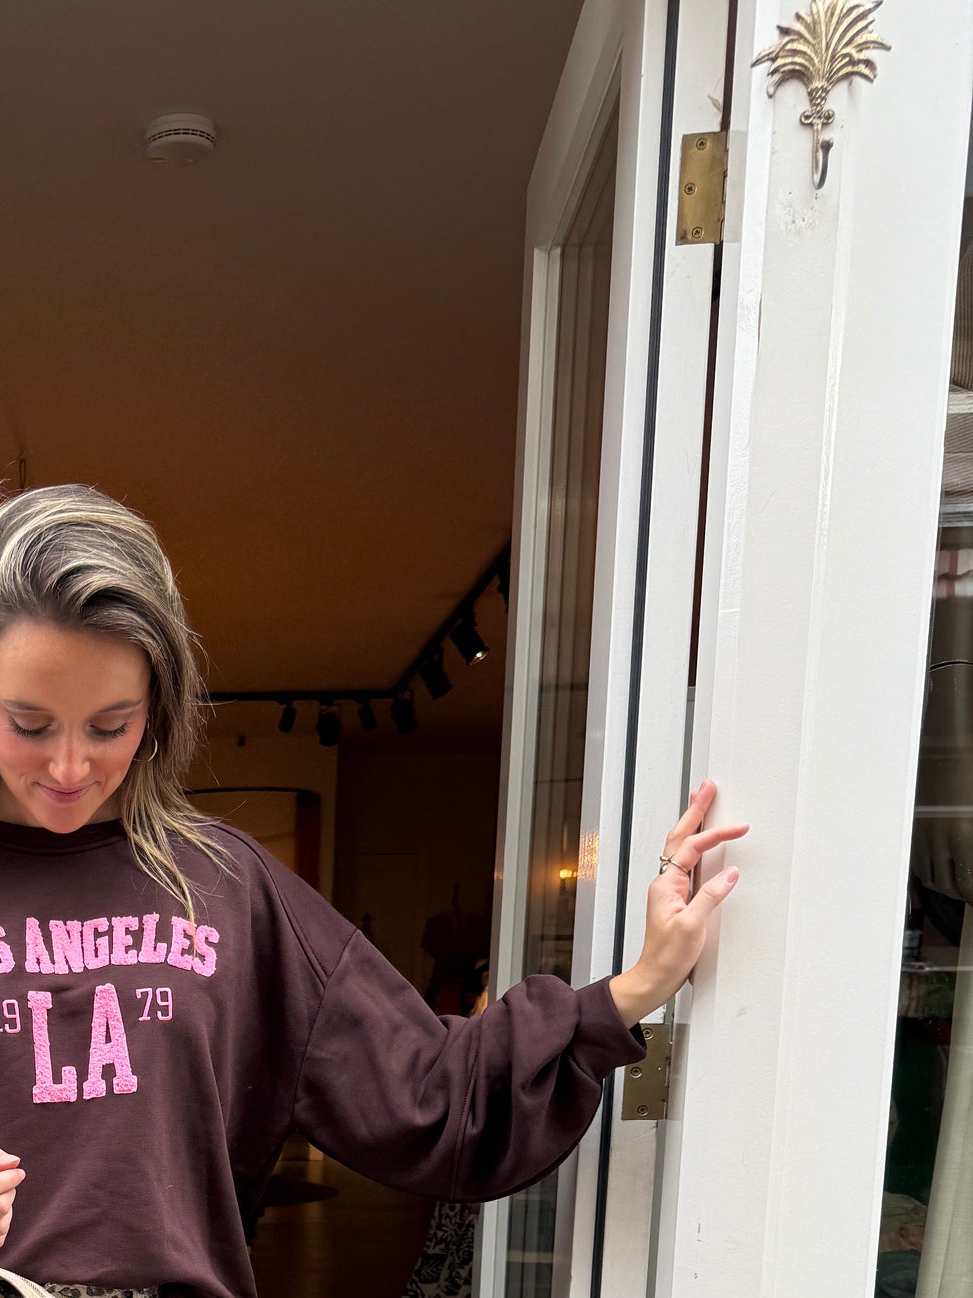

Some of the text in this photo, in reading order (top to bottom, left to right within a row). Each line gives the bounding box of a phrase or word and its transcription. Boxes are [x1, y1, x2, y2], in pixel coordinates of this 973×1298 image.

[25, 913, 220, 978] ANGELES
[27, 982, 138, 1105] LA
[135, 986, 174, 1022] 79
